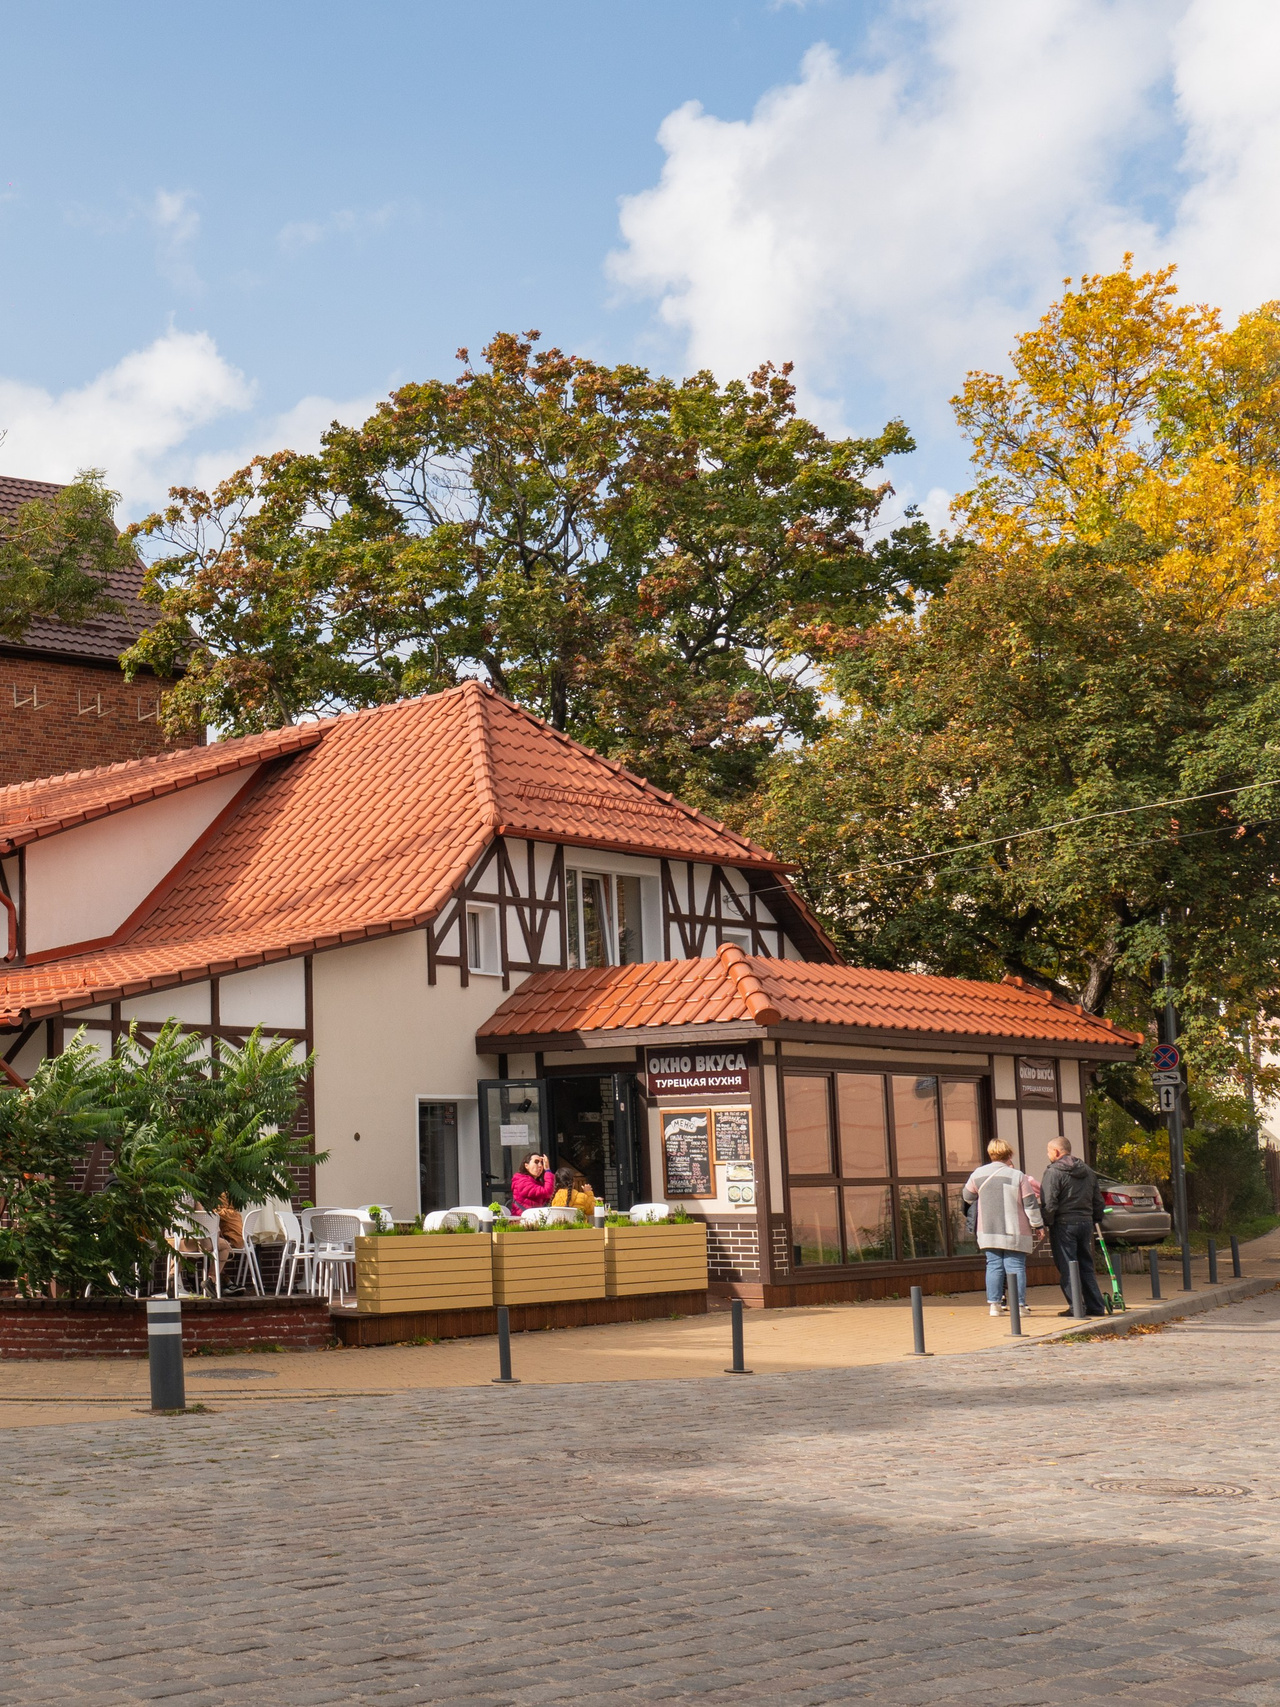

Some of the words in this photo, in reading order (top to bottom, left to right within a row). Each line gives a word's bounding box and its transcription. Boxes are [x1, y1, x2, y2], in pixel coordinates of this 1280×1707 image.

[649, 1056, 692, 1075] ОКНО
[695, 1053, 747, 1072] ВКУСА
[1019, 1067, 1036, 1079] ОКНО
[1037, 1068, 1055, 1081] ВКУСА
[655, 1077, 706, 1089] ТУРЕЦКАЯ
[708, 1075, 742, 1086] КУХНЯ
[673, 1119, 695, 1130] МЕНЮ
